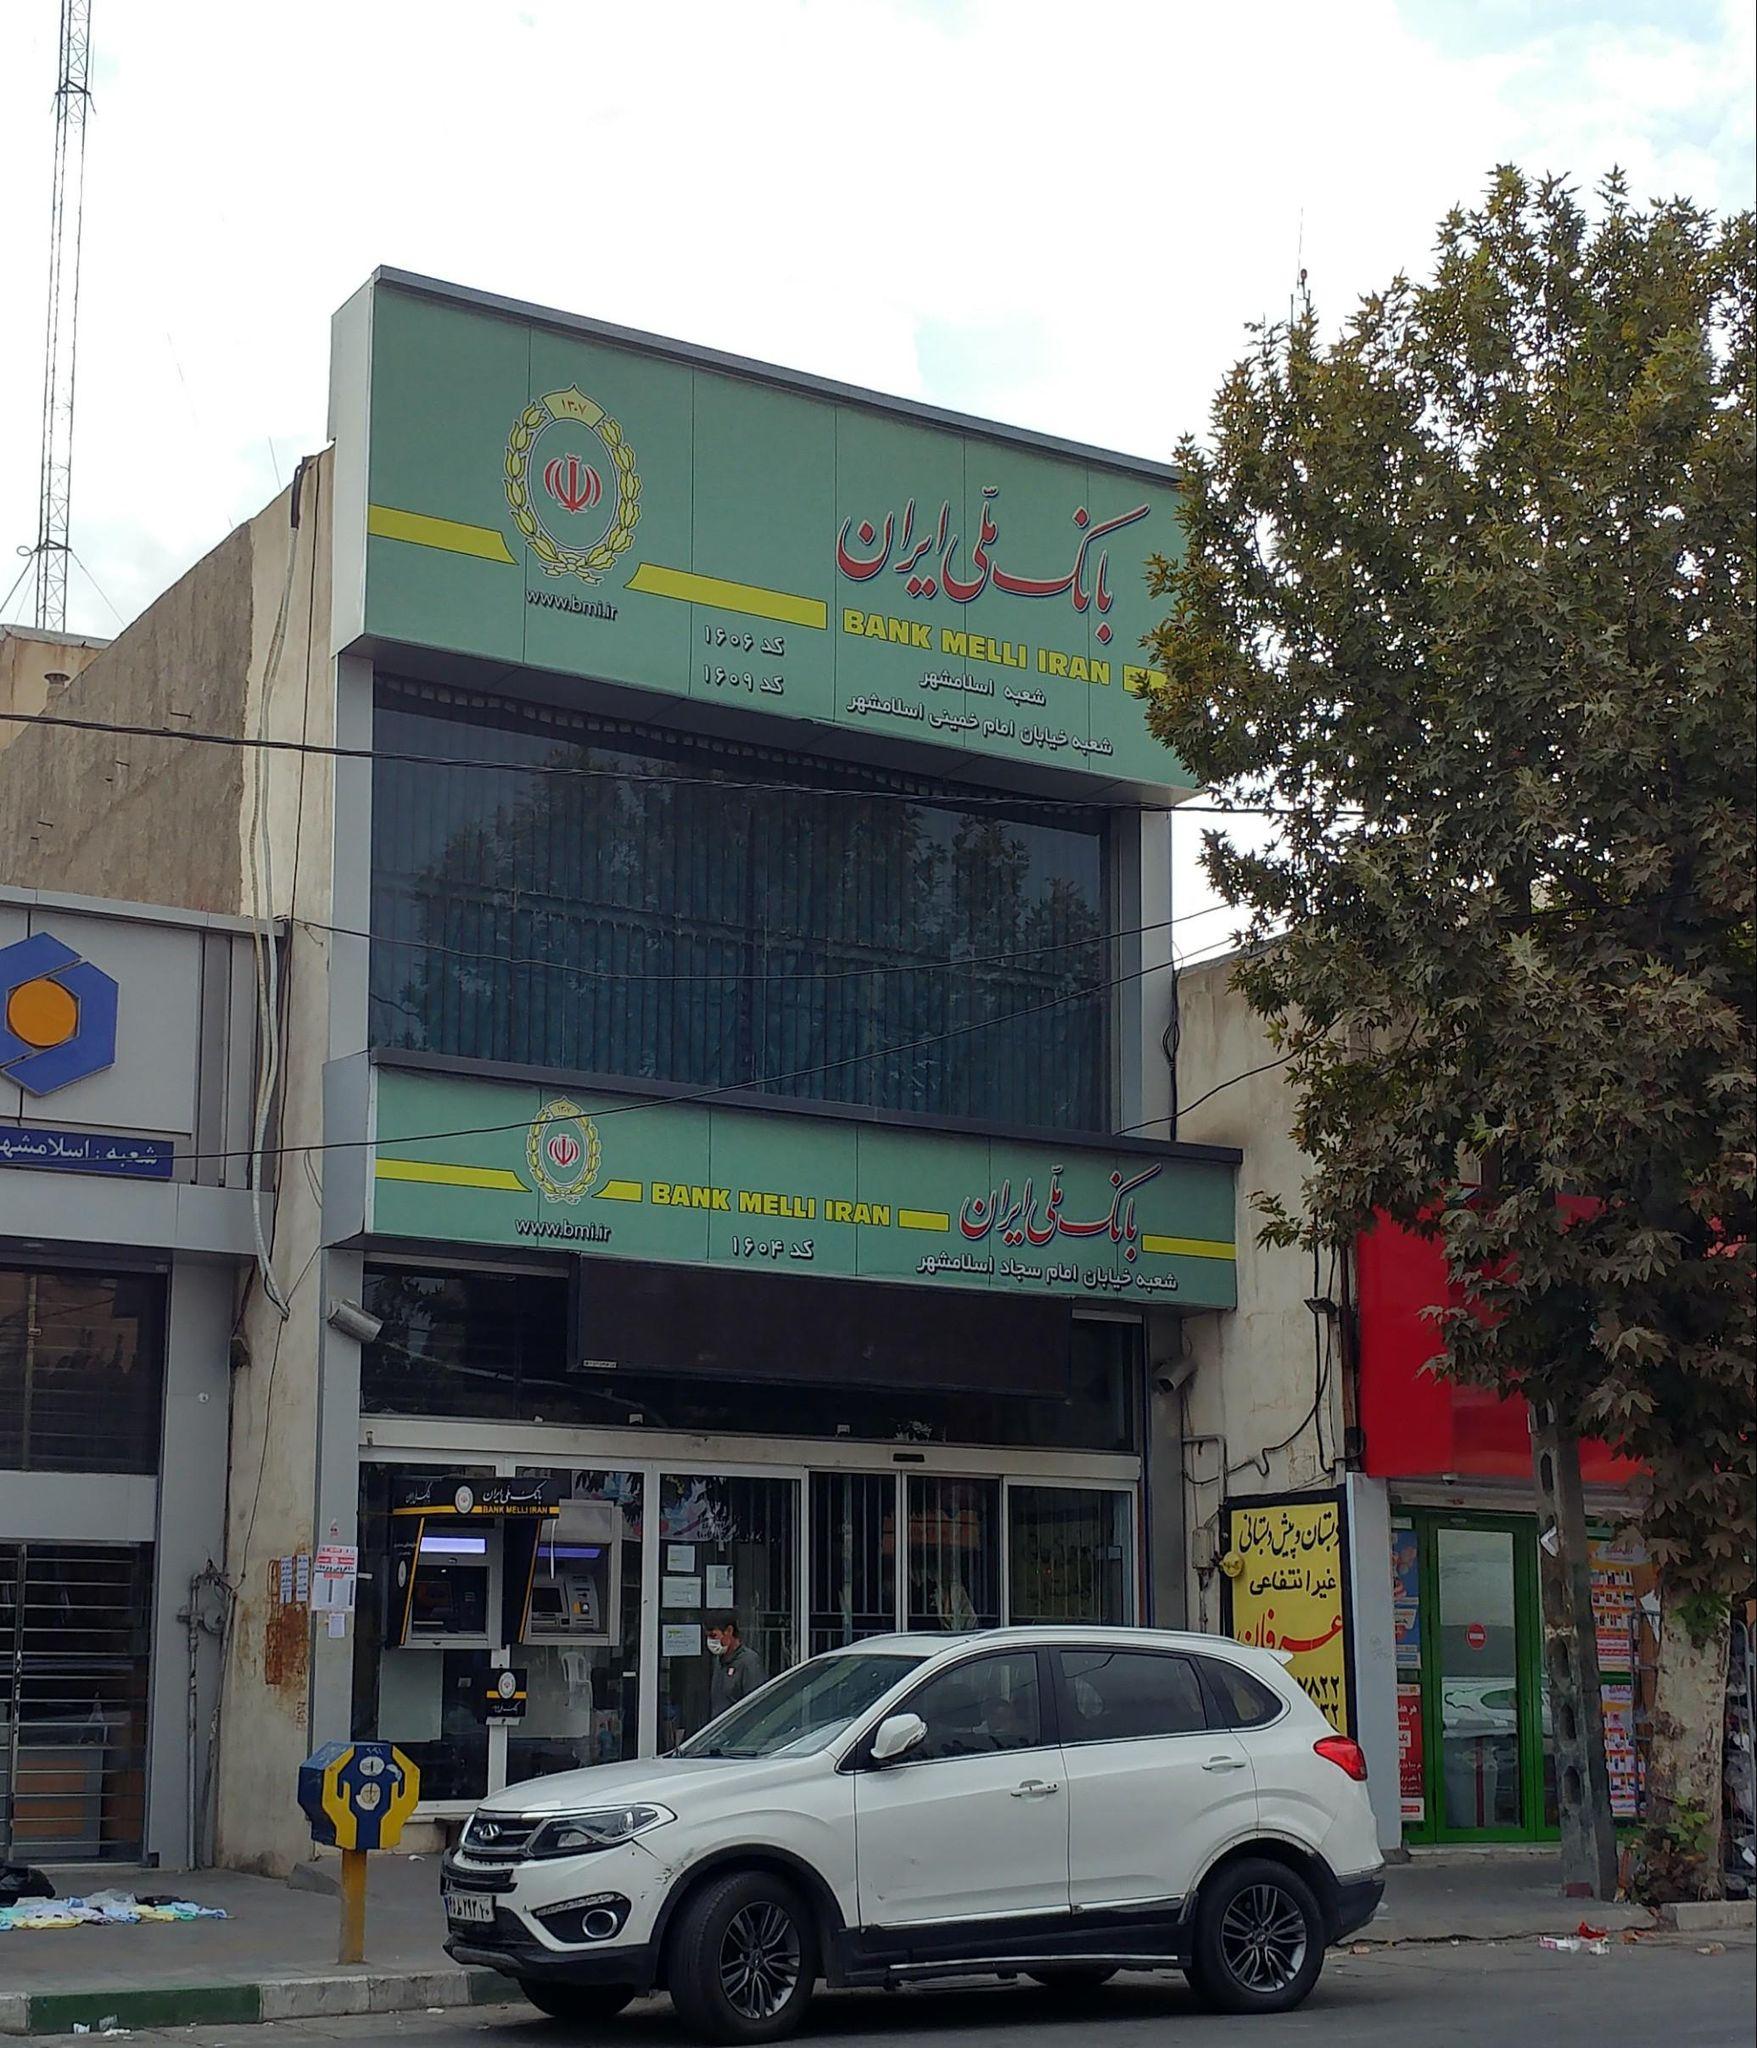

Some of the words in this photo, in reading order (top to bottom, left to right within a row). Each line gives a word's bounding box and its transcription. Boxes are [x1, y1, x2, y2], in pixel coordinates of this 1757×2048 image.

[837, 498, 949, 600] ایران
[991, 503, 1149, 645] بانک
[525, 588, 618, 621] www.bmi.ir
[704, 625, 753, 652] ۱۶۰۶
[760, 637, 784, 656] کد
[843, 607, 932, 650] BANK
[941, 629, 1027, 669] MELLI
[1038, 649, 1111, 686] IRAN
[704, 664, 753, 693] ۱۶۰۹
[760, 675, 784, 695] کد
[919, 669, 994, 695] اسلامشهر
[847, 692, 924, 720] اسلامشهر
[1003, 686, 1046, 706] شعبه
[928, 710, 979, 731] خمینی
[982, 720, 1015, 738] امام
[1020, 724, 1069, 747] خیابان
[1072, 735, 1114, 754] شعبه
[106, 1146, 157, 1167] شعبه
[651, 1182, 731, 1211] BANK
[738, 1190, 816, 1219] MELLI
[824, 1199, 890, 1227] IRAN
[959, 1177, 1033, 1246] ایران
[1057, 1163, 1161, 1262] بانک
[515, 1216, 611, 1241] www.bmi.ir
[732, 1236, 784, 1260] ۱۶۰۴
[790, 1239, 815, 1259] کد
[915, 1249, 994, 1275] اسلامشهر
[1000, 1259, 1042, 1282] سجاد
[1046, 1263, 1078, 1285] امام
[1083, 1267, 1132, 1290] خیابان
[1136, 1273, 1178, 1292] شعبه
[483, 1505, 505, 1514] BANK
[506, 1505, 528, 1514] MELLI
[529, 1506, 548, 1515] IRAN
[1239, 1514, 1273, 1555] دبستانی
[1271, 1512, 1296, 1559] پیش
[1301, 1512, 1339, 1552] دبستان
[1249, 1568, 1311, 1596] انتفاعی
[1310, 1568, 1337, 1598] غیر
